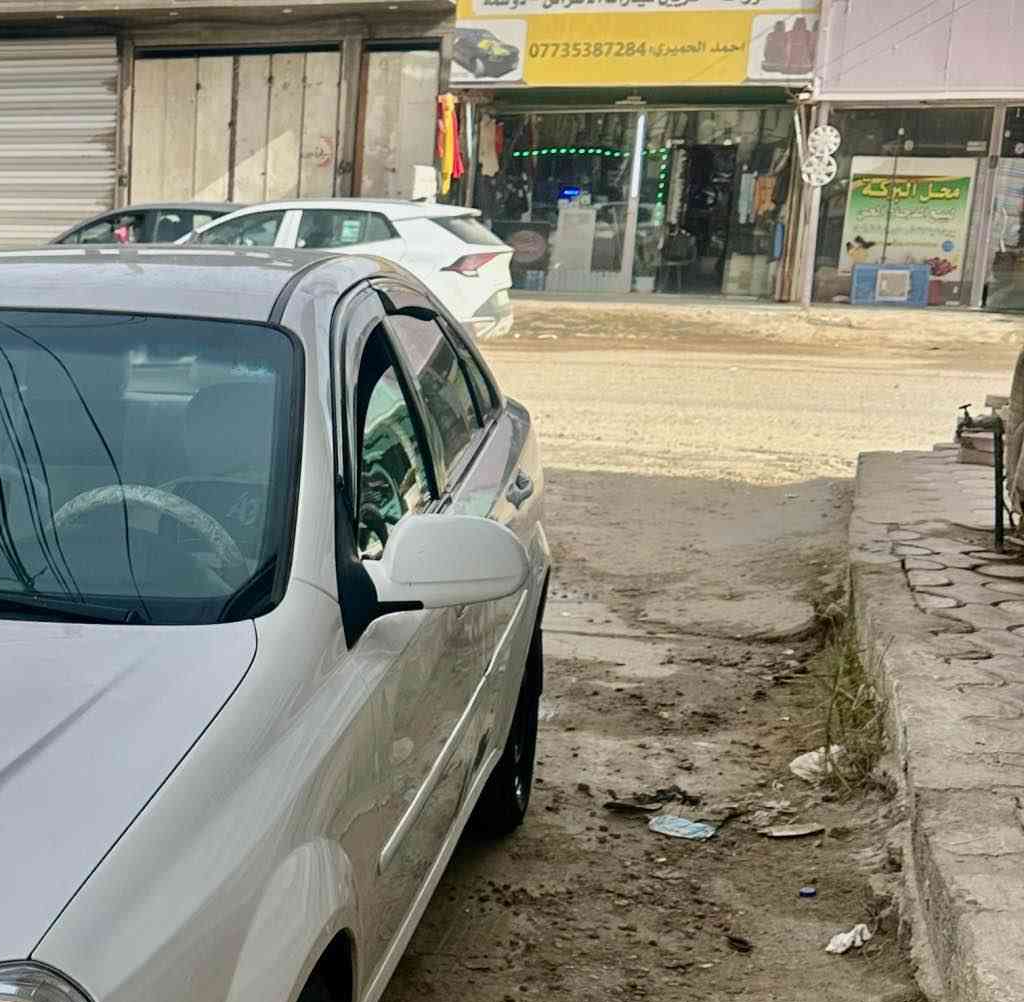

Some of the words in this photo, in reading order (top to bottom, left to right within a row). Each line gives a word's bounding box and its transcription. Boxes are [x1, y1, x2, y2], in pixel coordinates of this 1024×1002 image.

[528, 41, 646, 59] 07735387284
[862, 178, 918, 203] البركة
[919, 182, 961, 204] محل
